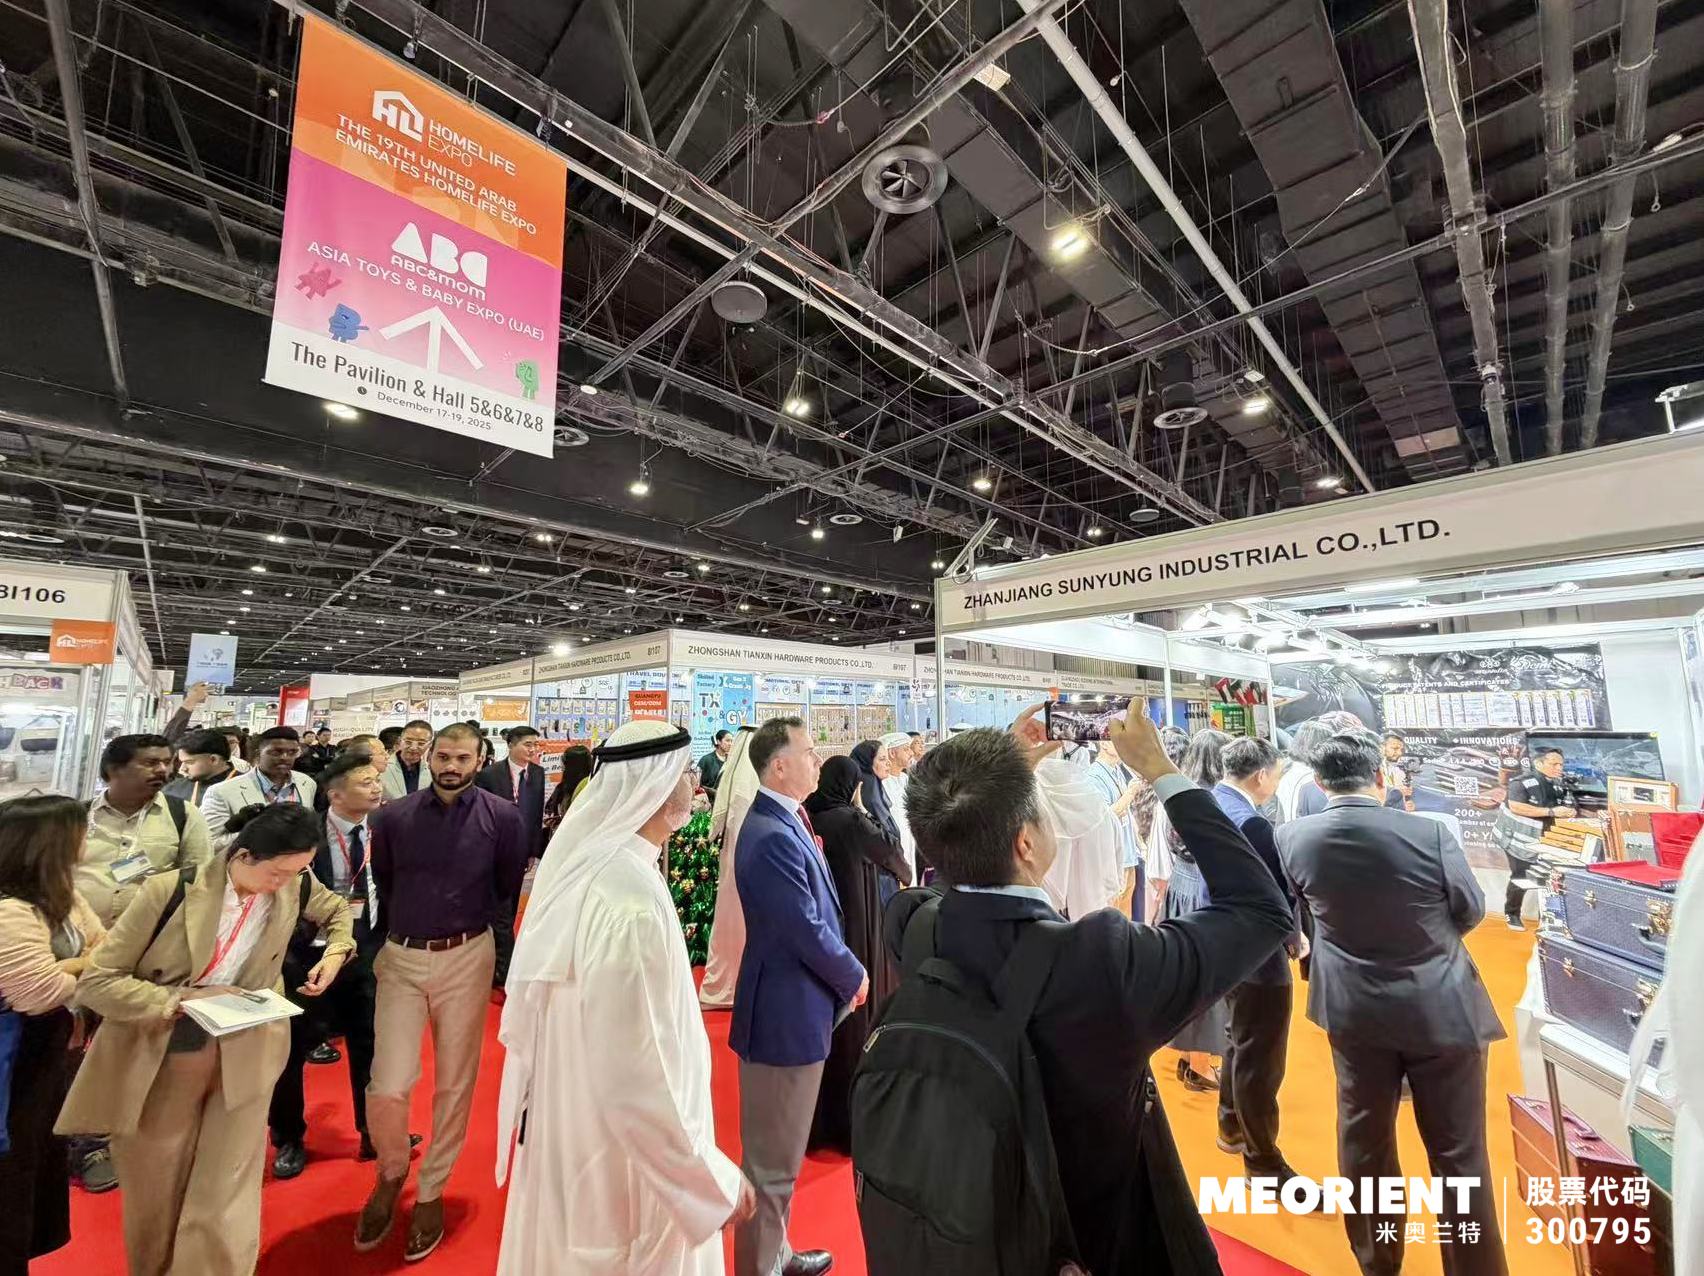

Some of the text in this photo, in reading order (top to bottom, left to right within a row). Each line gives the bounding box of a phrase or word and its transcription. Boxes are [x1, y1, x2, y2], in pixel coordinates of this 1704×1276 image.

[337, 113, 518, 213] THE 19TH UNITED ARAB
[428, 134, 473, 168] EXPO
[429, 118, 517, 177] HOMELIFE
[335, 127, 537, 235] EMIRATES HOMELIFE EXPO
[307, 241, 545, 342] ASIA TOYS & BABY EXPO (UAE)
[291, 341, 544, 433] The Pavilion & Hall 5&6&7&8
[377, 391, 492, 431] December 17-19, 2025
[964, 519, 1450, 610] ZHANJIANG SUNYUNG INDUSTRIAL CO.,LTD.
[687, 645, 742, 658] ZHONGSHAN
[743, 650, 773, 661] TIANXIN
[774, 653, 814, 664] HARDWARE
[815, 656, 849, 667] PRODUCTS
[1404, 736, 1438, 745] QUALITY
[1454, 808, 1482, 817] 200+
